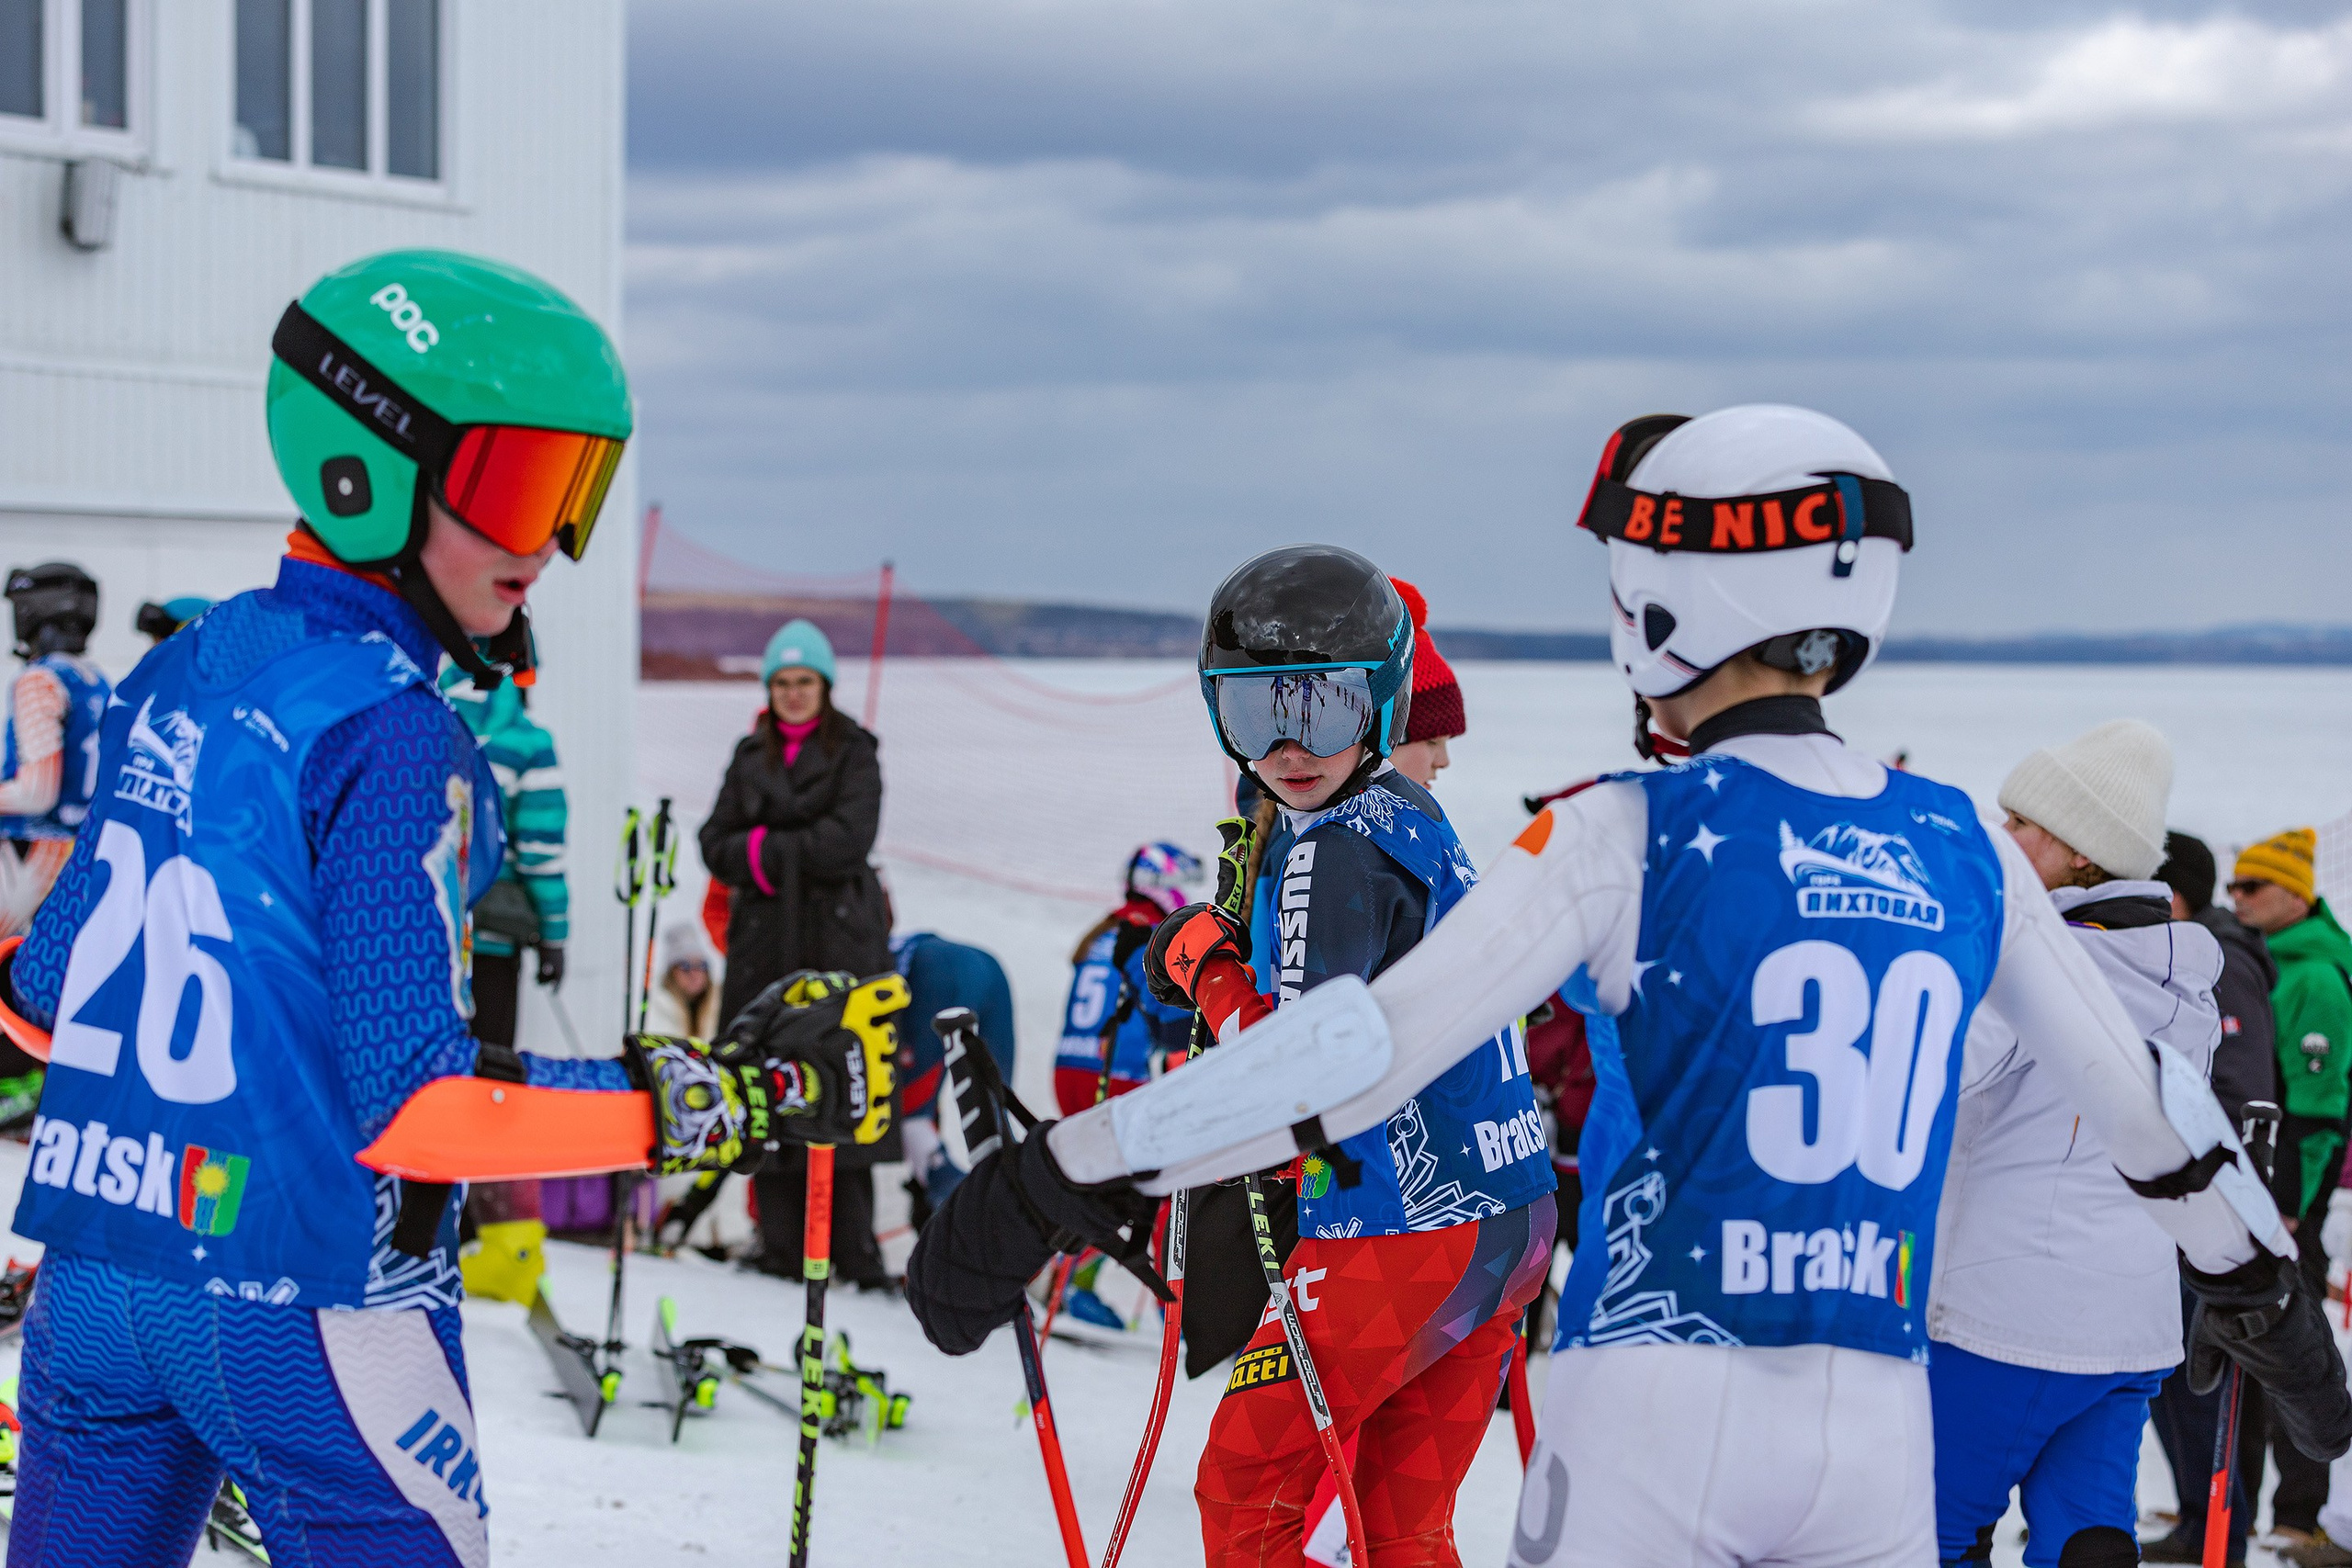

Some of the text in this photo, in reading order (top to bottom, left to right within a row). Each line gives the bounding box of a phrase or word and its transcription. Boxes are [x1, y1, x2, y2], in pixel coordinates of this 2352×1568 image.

[318, 351, 417, 443] LEVEL
[1623, 494, 1685, 545] BE
[1807, 892, 1939, 927] ПИХТОВАЯ
[50, 818, 238, 1104] 26
[1070, 965, 1110, 1030] 5
[739, 1064, 770, 1139] LEKI
[845, 1042, 866, 1120] LEVEL
[1747, 939, 1963, 1192] 30
[1474, 1099, 1548, 1173] Brats
[1250, 1191, 1281, 1269] LEKI
[1721, 1219, 1897, 1300] Brak
[800, 1322, 825, 1440] LEKI
